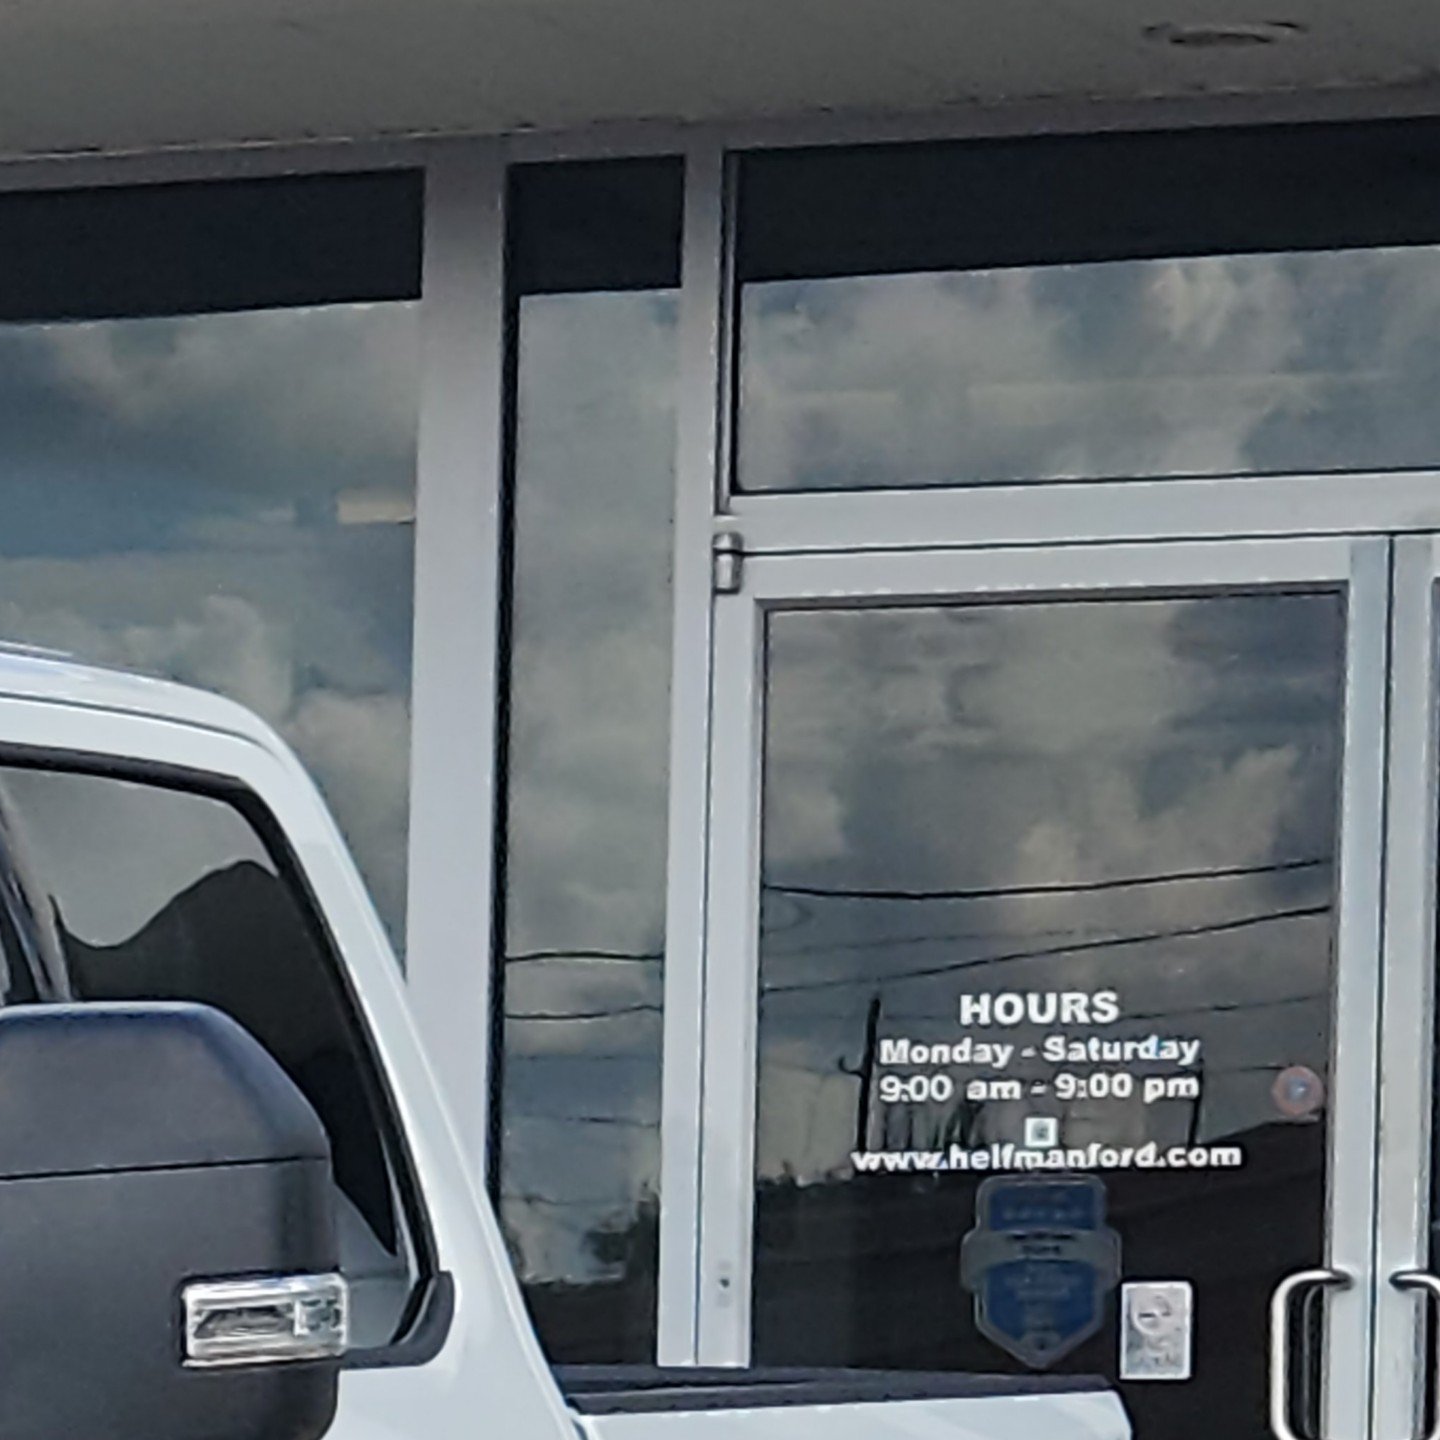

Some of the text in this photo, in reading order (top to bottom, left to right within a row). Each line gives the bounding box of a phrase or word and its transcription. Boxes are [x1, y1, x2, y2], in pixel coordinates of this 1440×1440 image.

[959, 991, 1120, 1026] HOURS
[879, 1038, 1014, 1069] Monday
[1041, 1034, 1201, 1066] Saturday
[879, 1074, 953, 1103] 9:00
[966, 1080, 1022, 1101] am
[1054, 1072, 1134, 1100] 9:00
[1142, 1077, 1200, 1104] pm
[850, 1142, 1243, 1172] www.helfmanford.com
